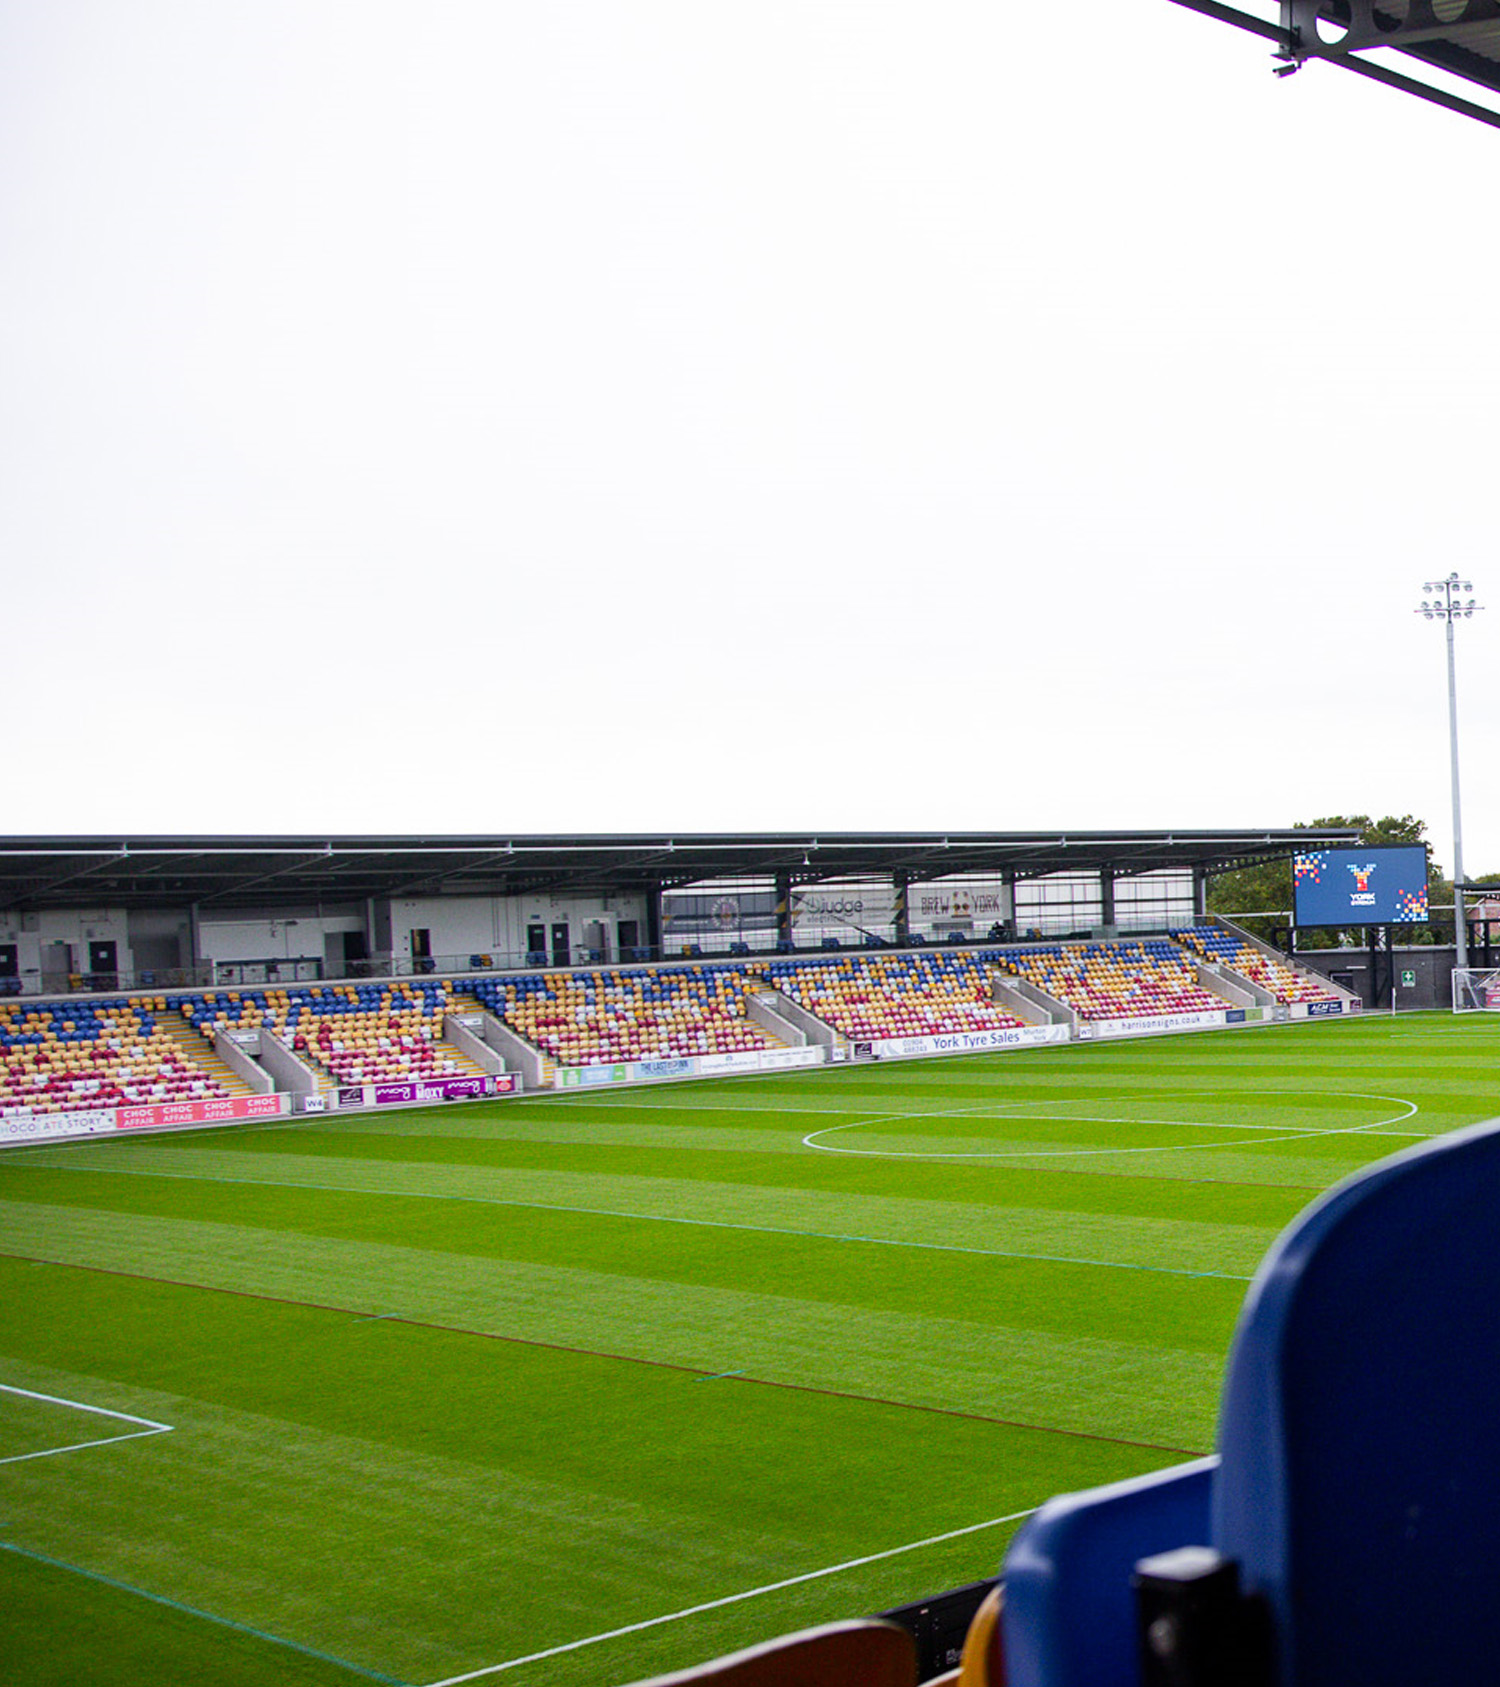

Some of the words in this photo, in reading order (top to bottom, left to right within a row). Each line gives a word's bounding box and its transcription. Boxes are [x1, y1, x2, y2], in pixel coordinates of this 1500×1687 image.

[921, 896, 949, 915] BREW
[972, 894, 1000, 913] YORK
[933, 1036, 959, 1049] York
[962, 1035, 987, 1048] Tyre
[990, 1031, 1020, 1044] Sales
[204, 1101, 234, 1110] CHOC
[246, 1097, 276, 1107] CHOC
[123, 1108, 155, 1118] CHOC
[162, 1105, 193, 1114] CHOC
[204, 1109, 234, 1119] AFFAIR
[247, 1105, 276, 1115] AFFAIR
[123, 1117, 155, 1127] AFFAIR
[163, 1113, 193, 1122] AFFAIR
